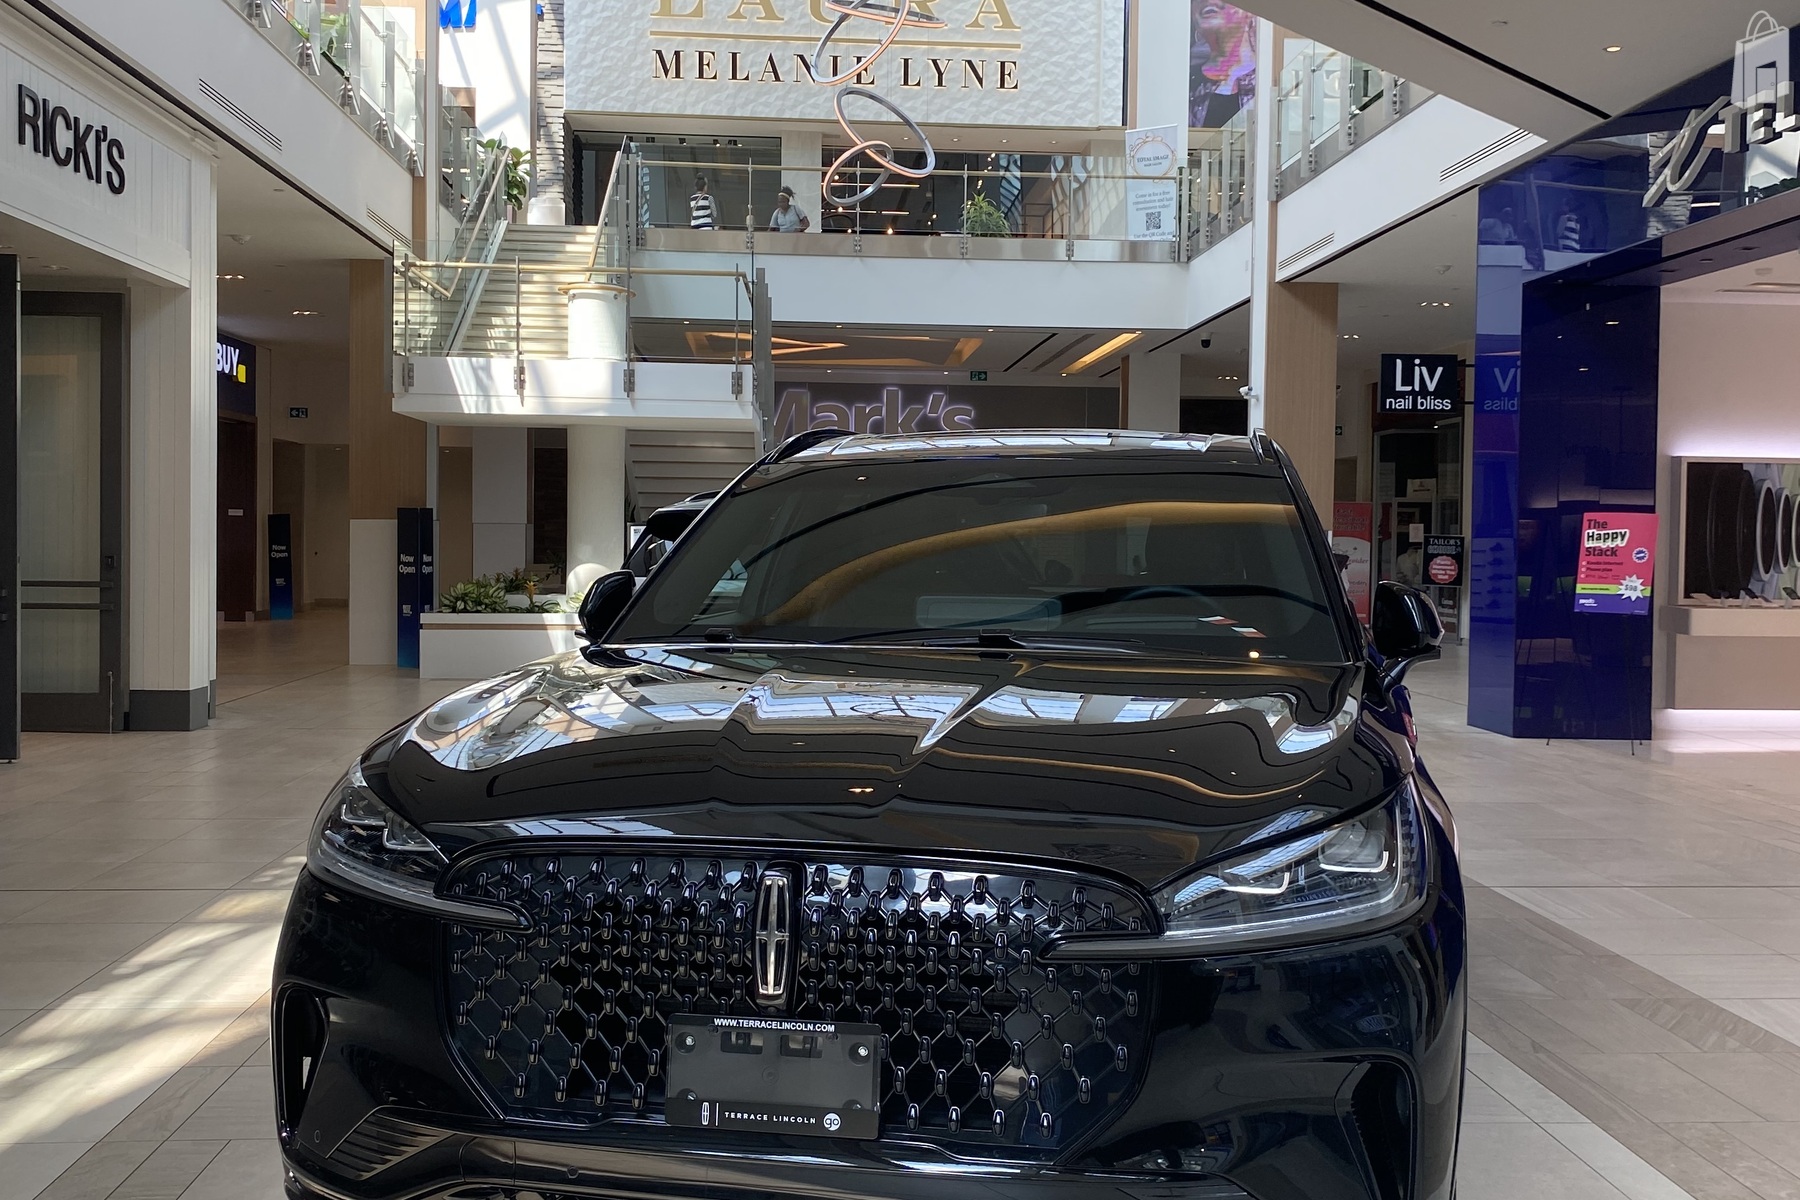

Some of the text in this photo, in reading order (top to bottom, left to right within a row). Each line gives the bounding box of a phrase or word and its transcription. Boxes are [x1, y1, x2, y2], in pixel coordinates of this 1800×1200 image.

[652, 49, 1020, 90] MELANIE LYNE
[18, 83, 126, 195] RICKI'S
[217, 342, 240, 376] BUY
[1395, 358, 1444, 392] Liv
[1386, 395, 1452, 410] nail bliss
[1587, 519, 1608, 529] The
[1428, 538, 1461, 546] TAILOR'S
[1586, 530, 1628, 544] Happy
[270, 551, 289, 559] Open
[1585, 546, 1618, 557] Stack
[400, 553, 415, 563] Now
[422, 553, 433, 563] Now
[398, 564, 416, 575] Open
[421, 564, 434, 575] Open
[714, 1017, 835, 1033] WWW.TERRACELINCOLN.COM
[724, 1111, 769, 1121] TERRACE
[773, 1115, 816, 1124] LINCOLN
